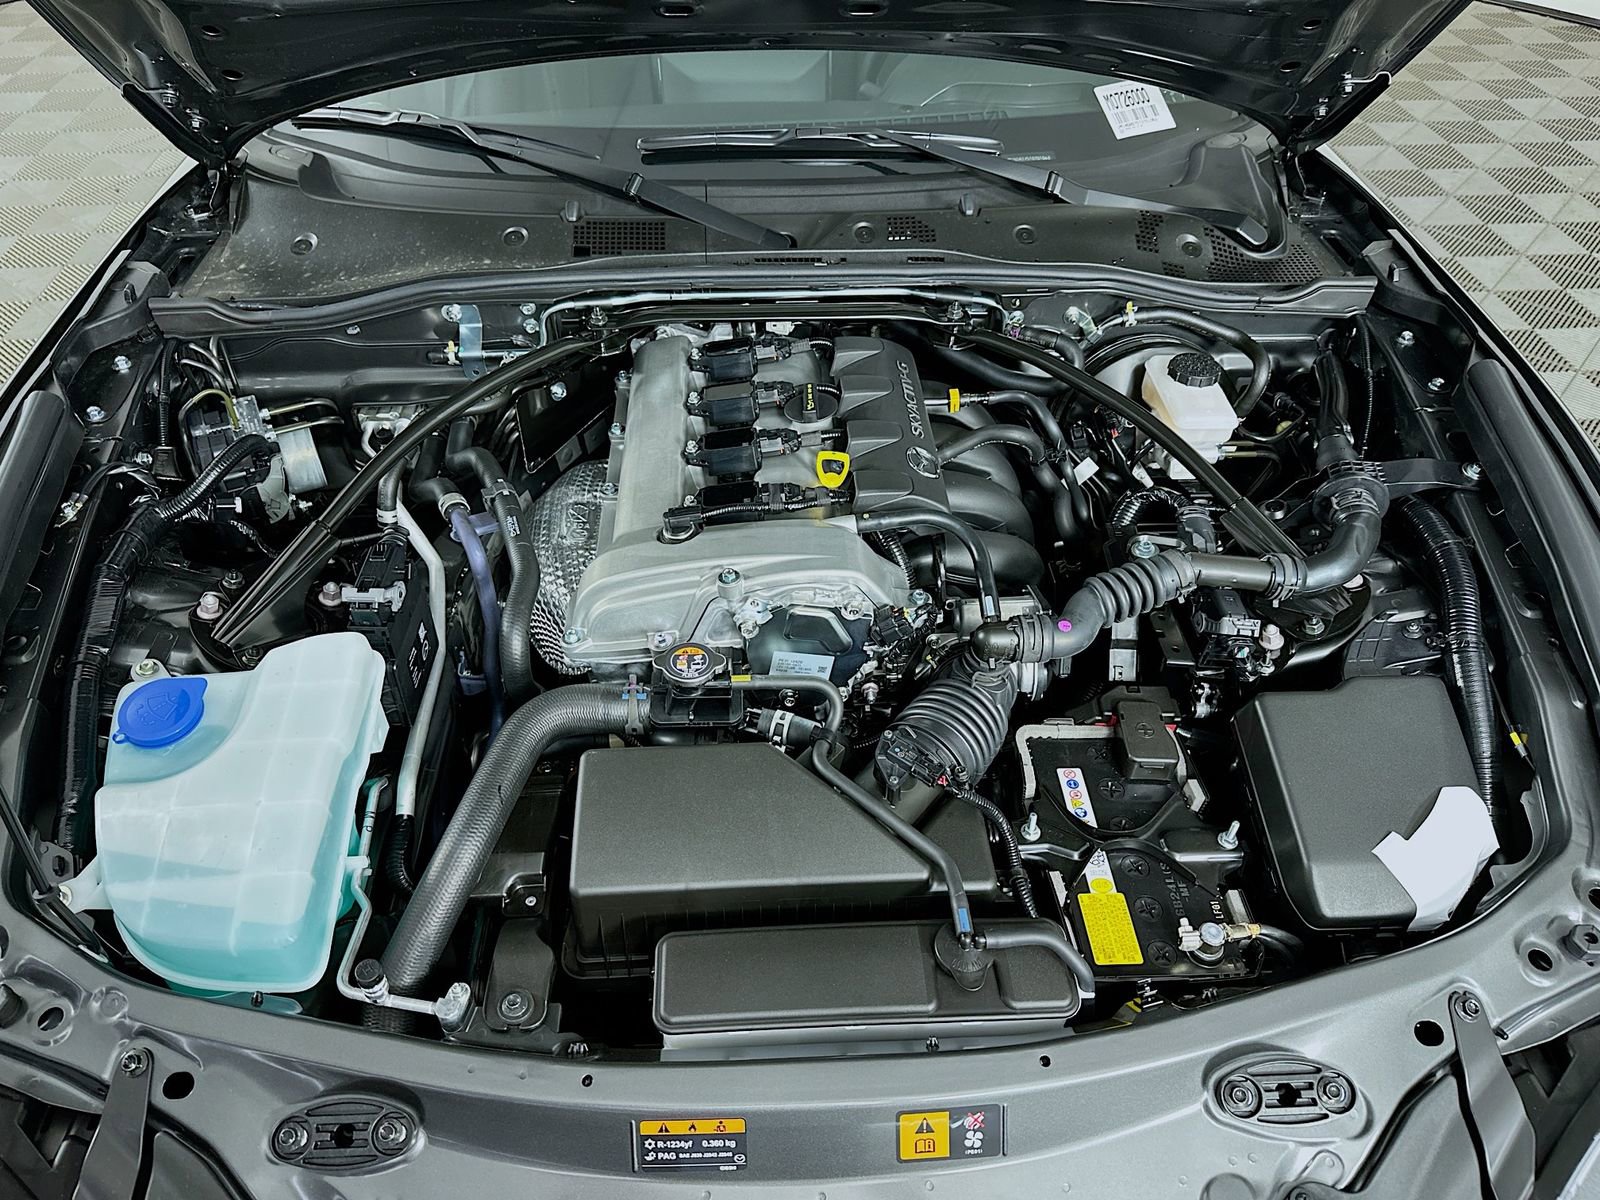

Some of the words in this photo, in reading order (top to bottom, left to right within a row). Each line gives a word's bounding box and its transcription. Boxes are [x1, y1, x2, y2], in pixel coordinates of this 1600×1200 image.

[896, 359, 925, 440] SKYACTIV-G
[656, 1140, 693, 1149] R-1234yf
[725, 1139, 737, 1148] kg
[657, 1152, 677, 1160] PAG
